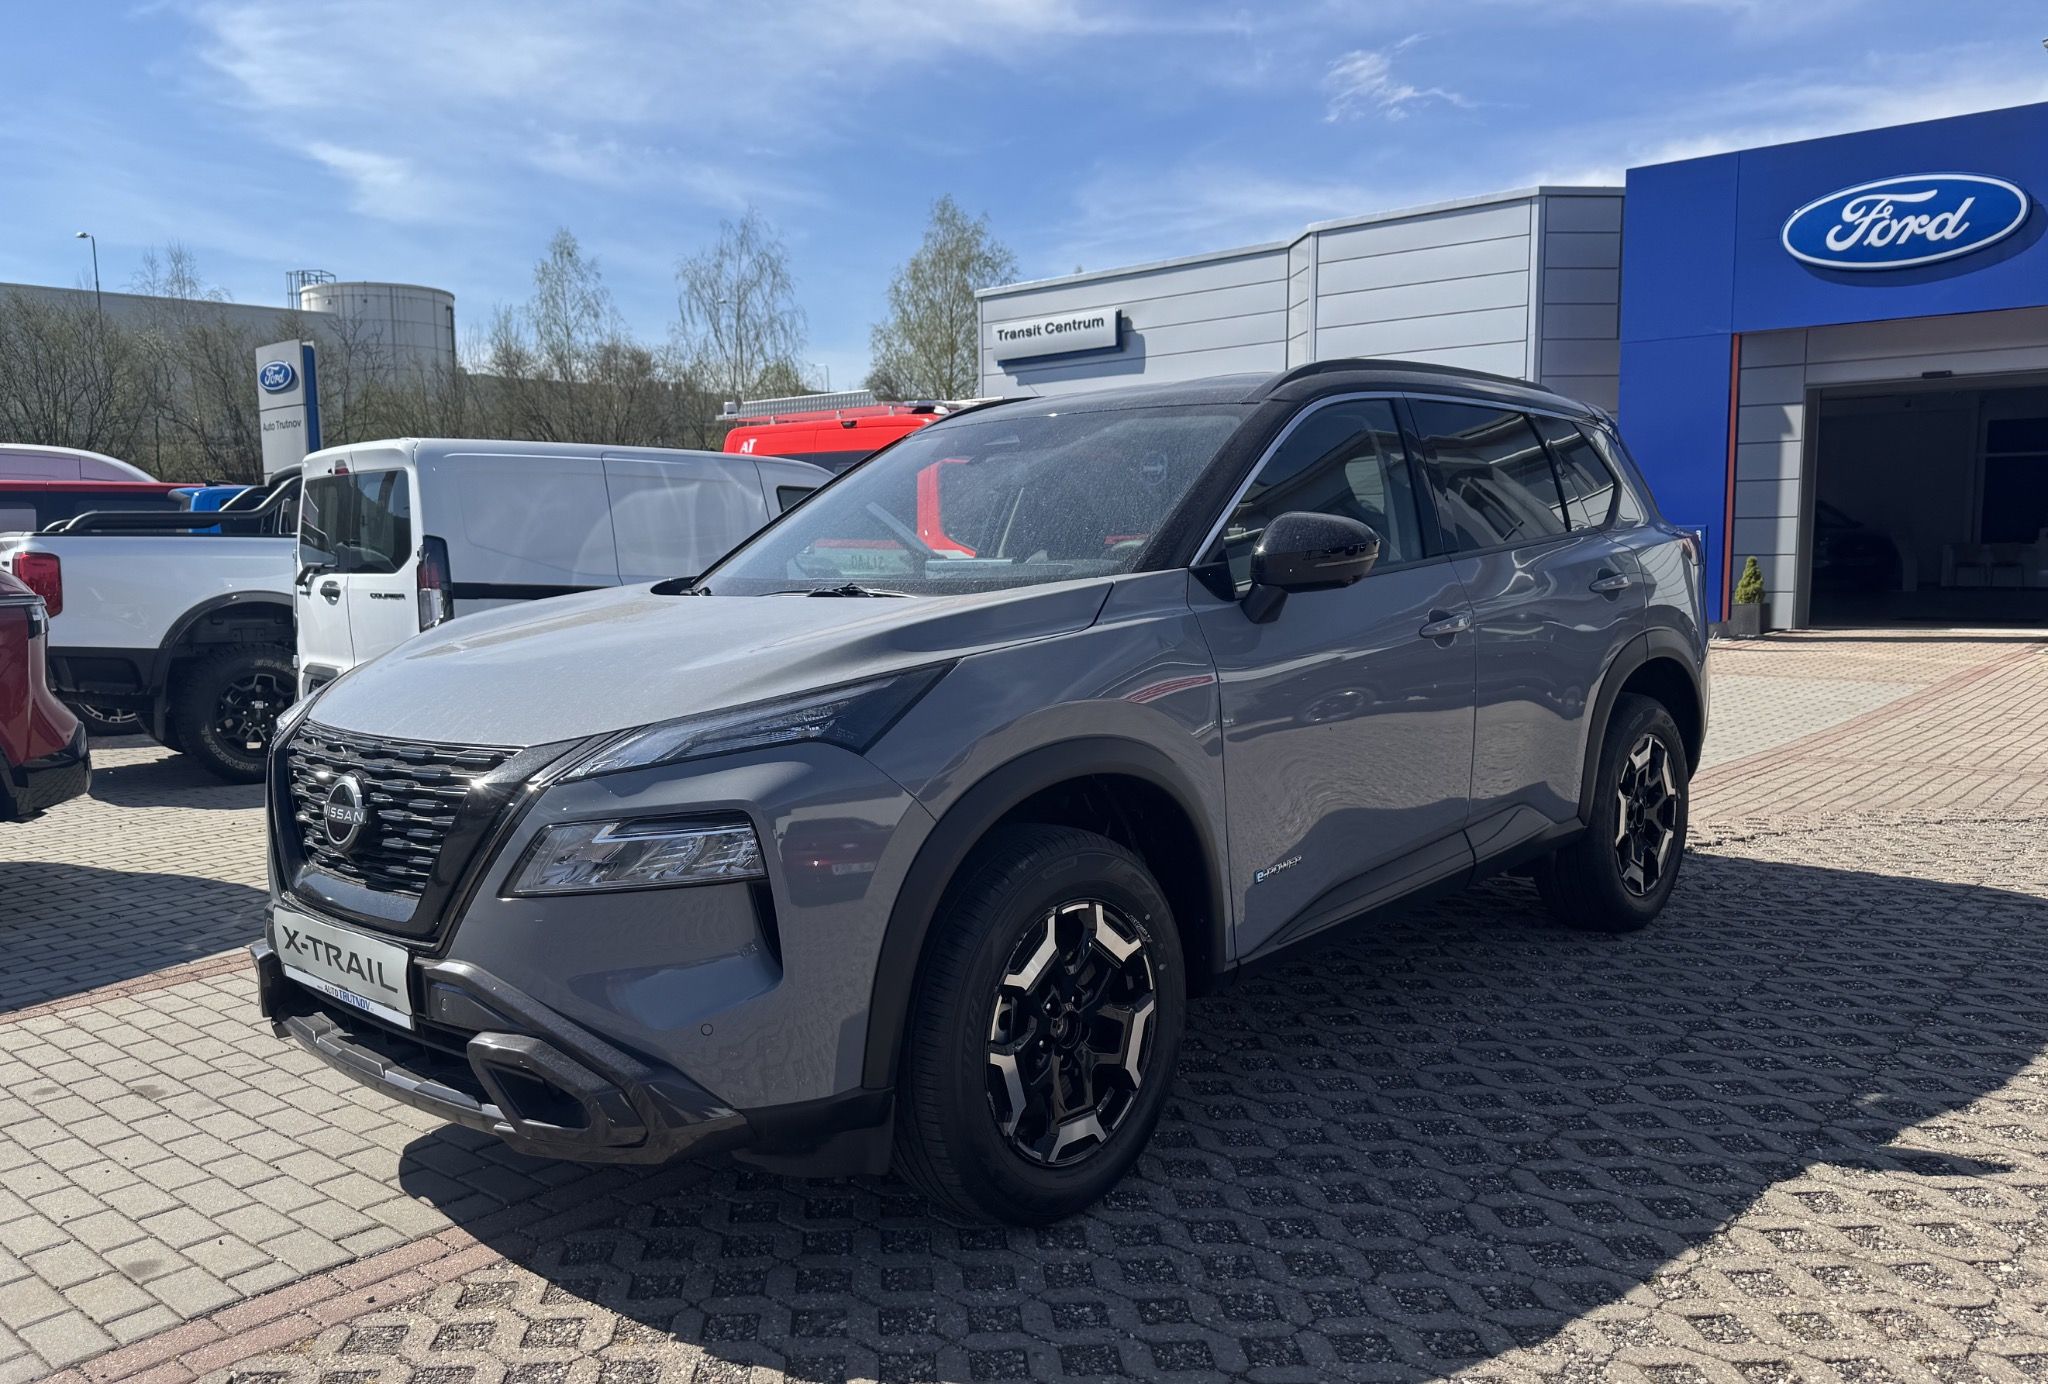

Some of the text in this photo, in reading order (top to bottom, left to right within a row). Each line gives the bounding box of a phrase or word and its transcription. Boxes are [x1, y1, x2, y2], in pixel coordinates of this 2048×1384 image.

[1826, 188, 1976, 252] Ford
[997, 316, 1104, 341] Transit Centrum
[264, 365, 285, 386] Ford
[263, 419, 302, 432] Auto Trutnov
[739, 438, 757, 453] AT
[323, 803, 364, 823] NISSAN
[281, 925, 398, 994] X-TRAIL
[324, 984, 370, 1011] AUTO TRUTNOV
